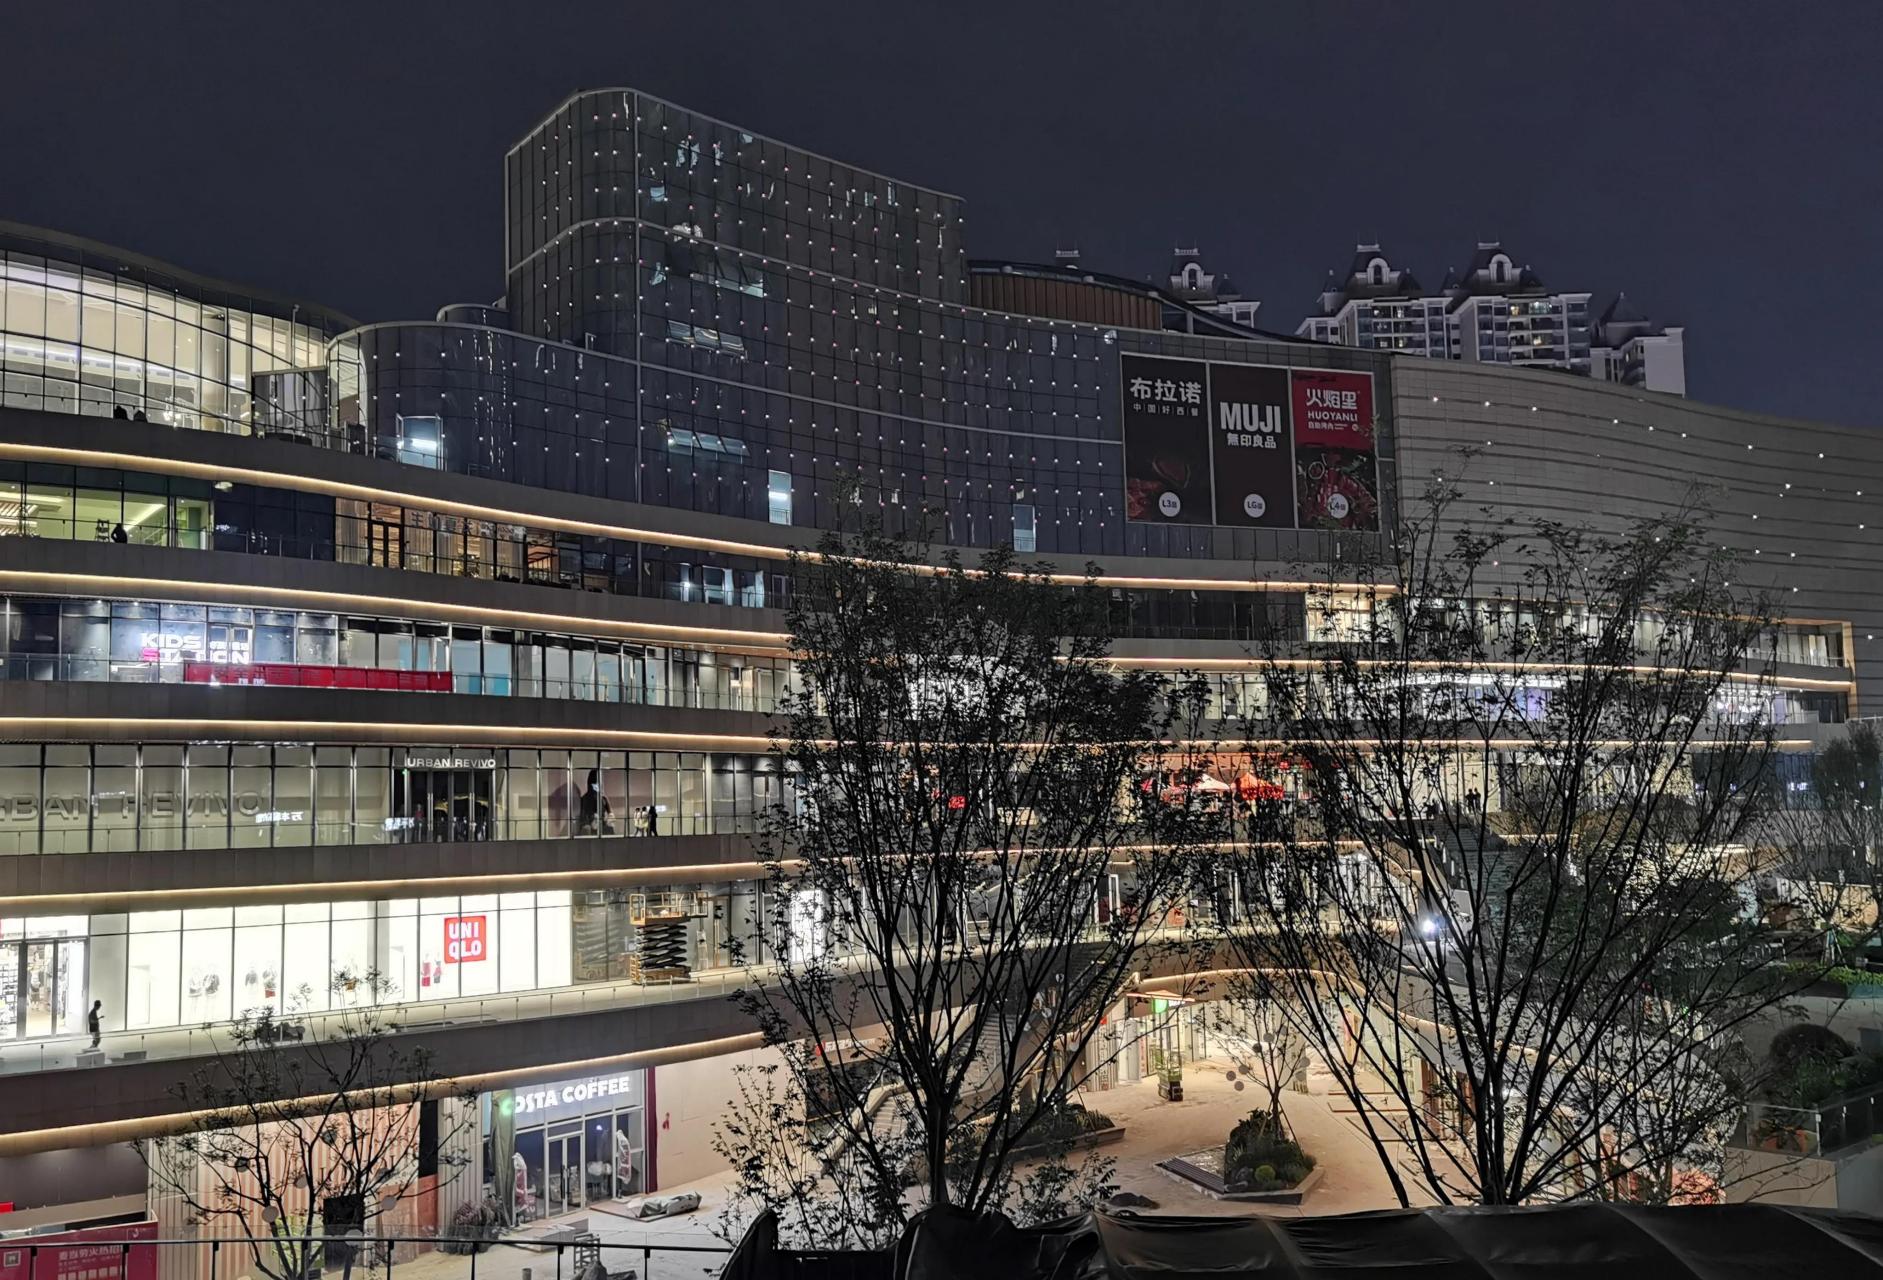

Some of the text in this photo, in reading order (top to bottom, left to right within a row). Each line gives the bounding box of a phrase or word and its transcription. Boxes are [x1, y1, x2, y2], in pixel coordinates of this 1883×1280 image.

[1129, 377, 1202, 404] 布拉诺
[1220, 401, 1282, 433] MUJI
[1227, 432, 1277, 449] 無印良品
[142, 633, 201, 649] KIDS
[407, 758, 496, 768] URBAN REVIVO
[448, 921, 480, 940] UNI
[448, 940, 482, 960] QLO
[562, 1076, 630, 1103] COFFEE
